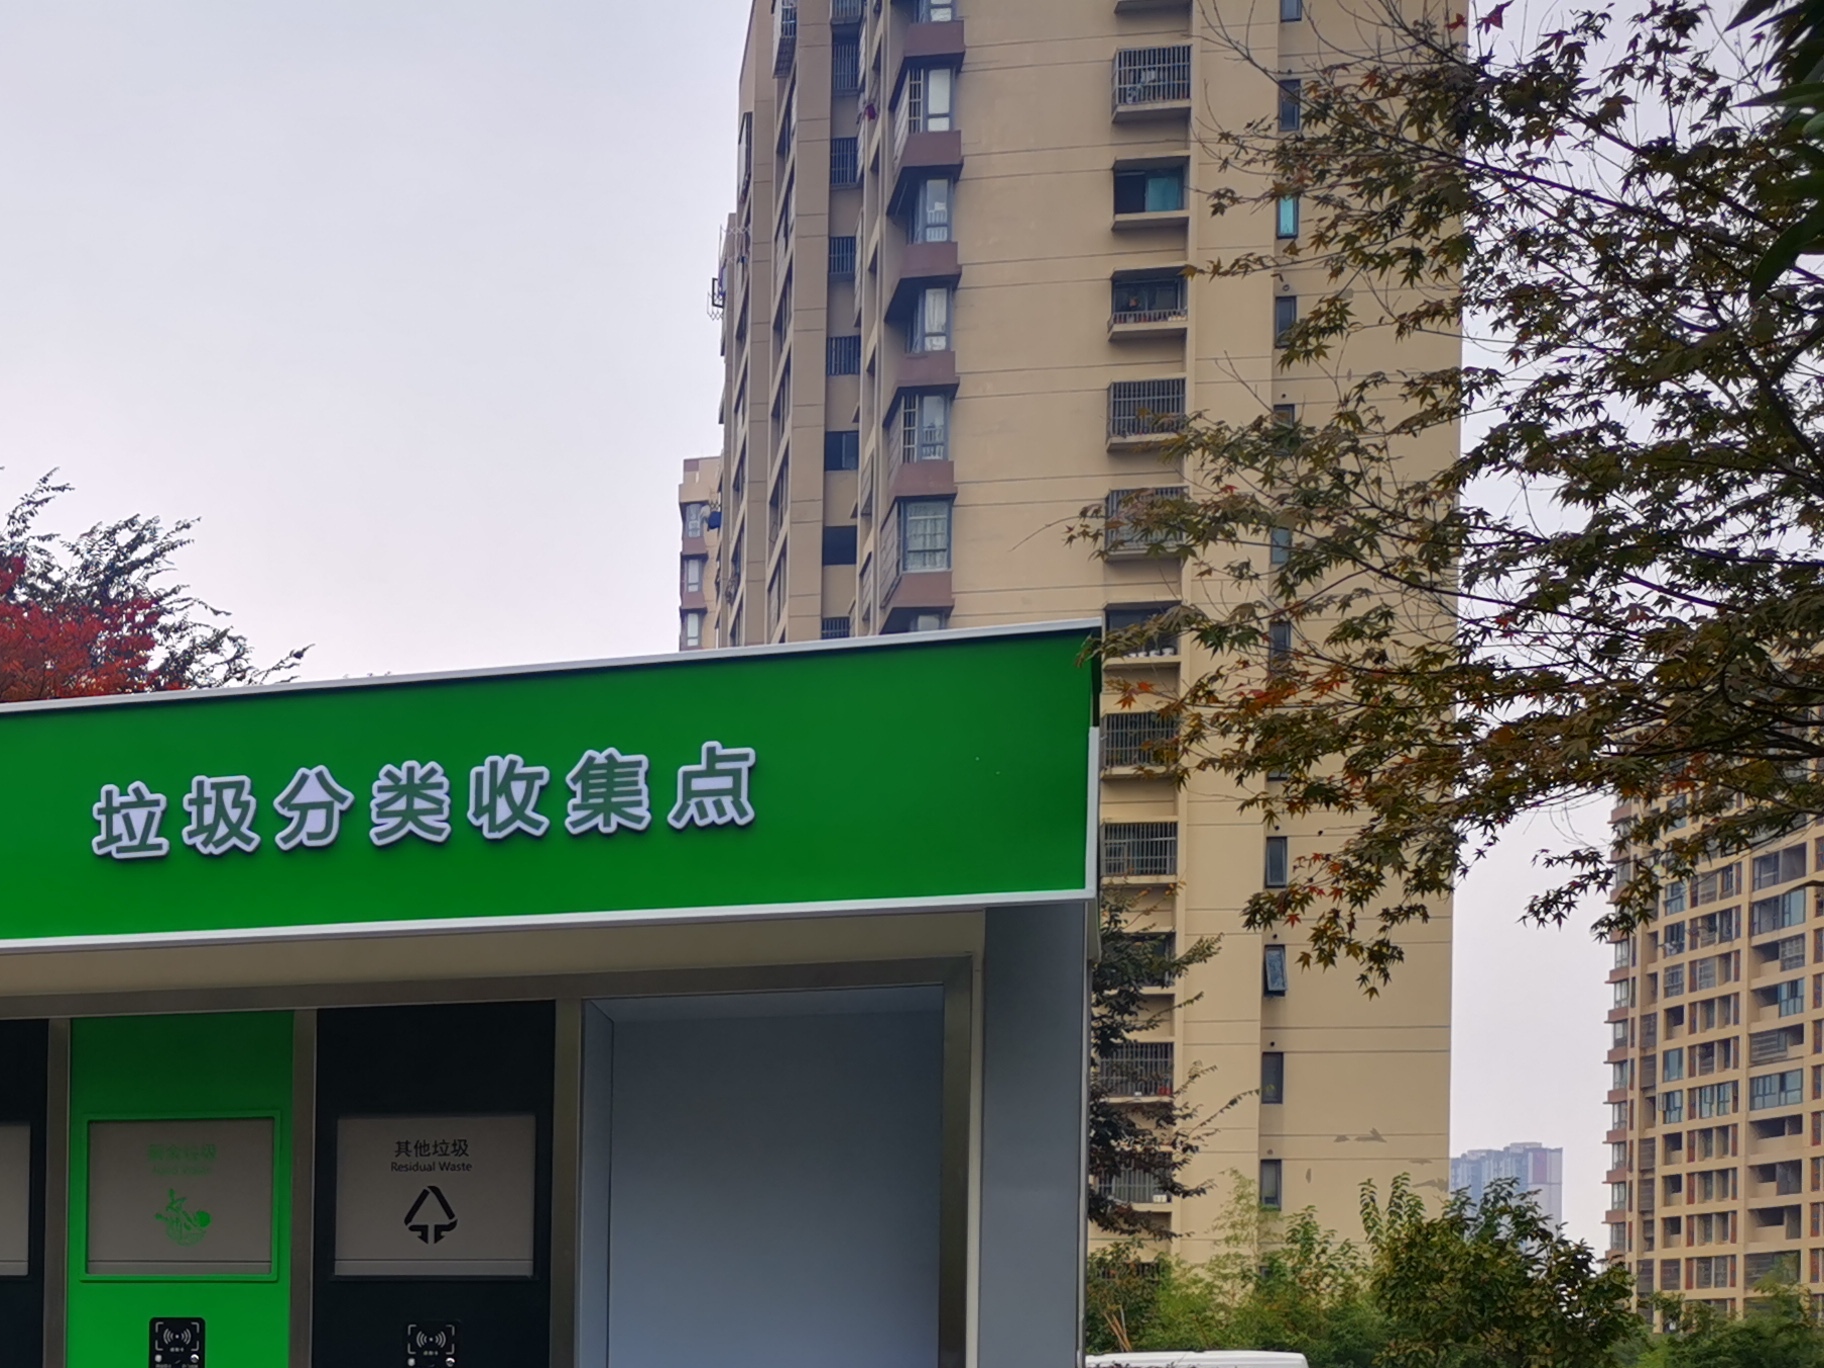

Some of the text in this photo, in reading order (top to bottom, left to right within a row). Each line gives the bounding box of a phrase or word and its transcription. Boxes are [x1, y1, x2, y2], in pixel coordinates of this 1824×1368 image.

[92, 741, 756, 859] 垃圾分类收集点
[395, 1139, 469, 1157] 其他垃圾
[391, 1161, 473, 1172] Residual Waste
